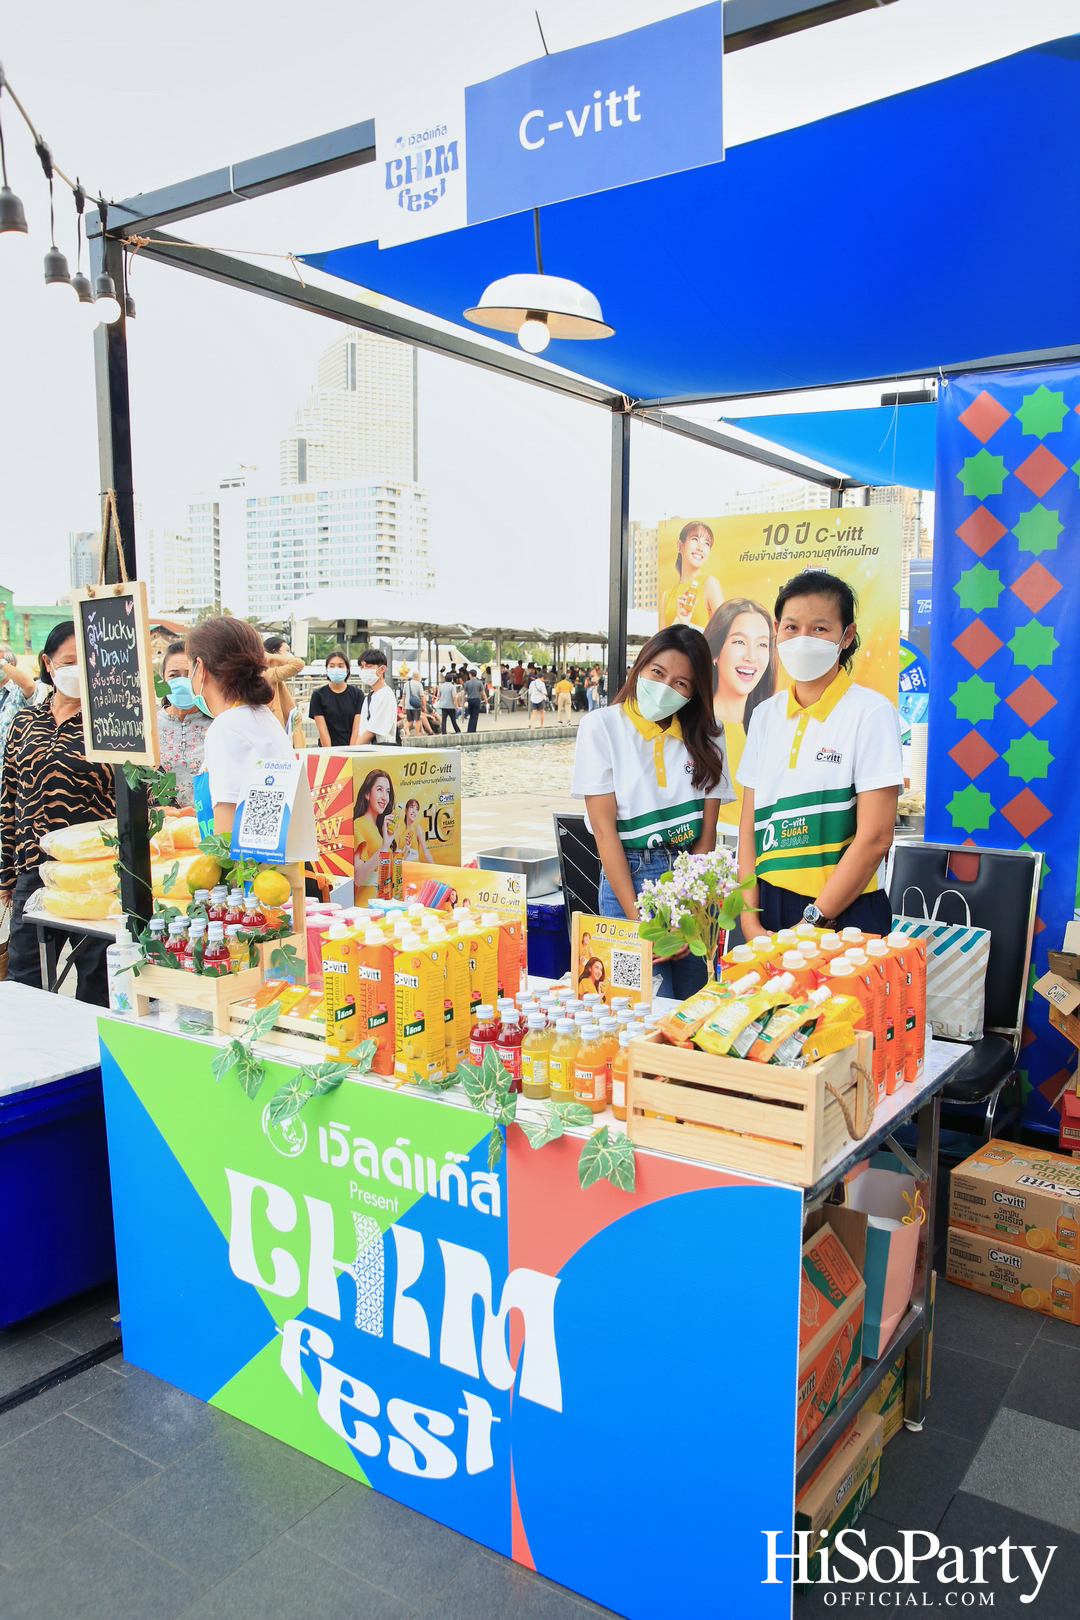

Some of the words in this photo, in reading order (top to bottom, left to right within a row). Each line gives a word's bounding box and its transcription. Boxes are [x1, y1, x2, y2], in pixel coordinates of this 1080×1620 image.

[519, 85, 641, 150] C-vitt
[397, 177, 446, 212] fest
[762, 523, 789, 546] 10
[795, 521, 810, 545] ปี
[815, 526, 863, 543] C-vitt
[103, 617, 135, 650] Lucky
[100, 648, 129, 667] Draw
[816, 752, 841, 763] C-vitt
[403, 761, 418, 777] 10
[419, 760, 428, 775] ปี
[430, 764, 452, 775] C-vitt
[668, 823, 690, 837] C-vitt
[781, 825, 808, 838] SUGAR
[782, 817, 806, 829] C-vitt
[670, 829, 694, 844] SUGAR
[478, 891, 490, 903] 10
[500, 896, 520, 907] C-vitt
[595, 922, 607, 934] 10
[323, 960, 347, 973] C-vitt
[1047, 985, 1066, 1003] C-vitt
[318, 1120, 501, 1218] เวิลด์แก๊ส
[349, 1180, 399, 1213] Present
[994, 1193, 1025, 1208] C-vitt
[990, 1250, 1021, 1268] C-vitt
[798, 1374, 815, 1401] -vitt
[274, 1319, 501, 1480] fest
